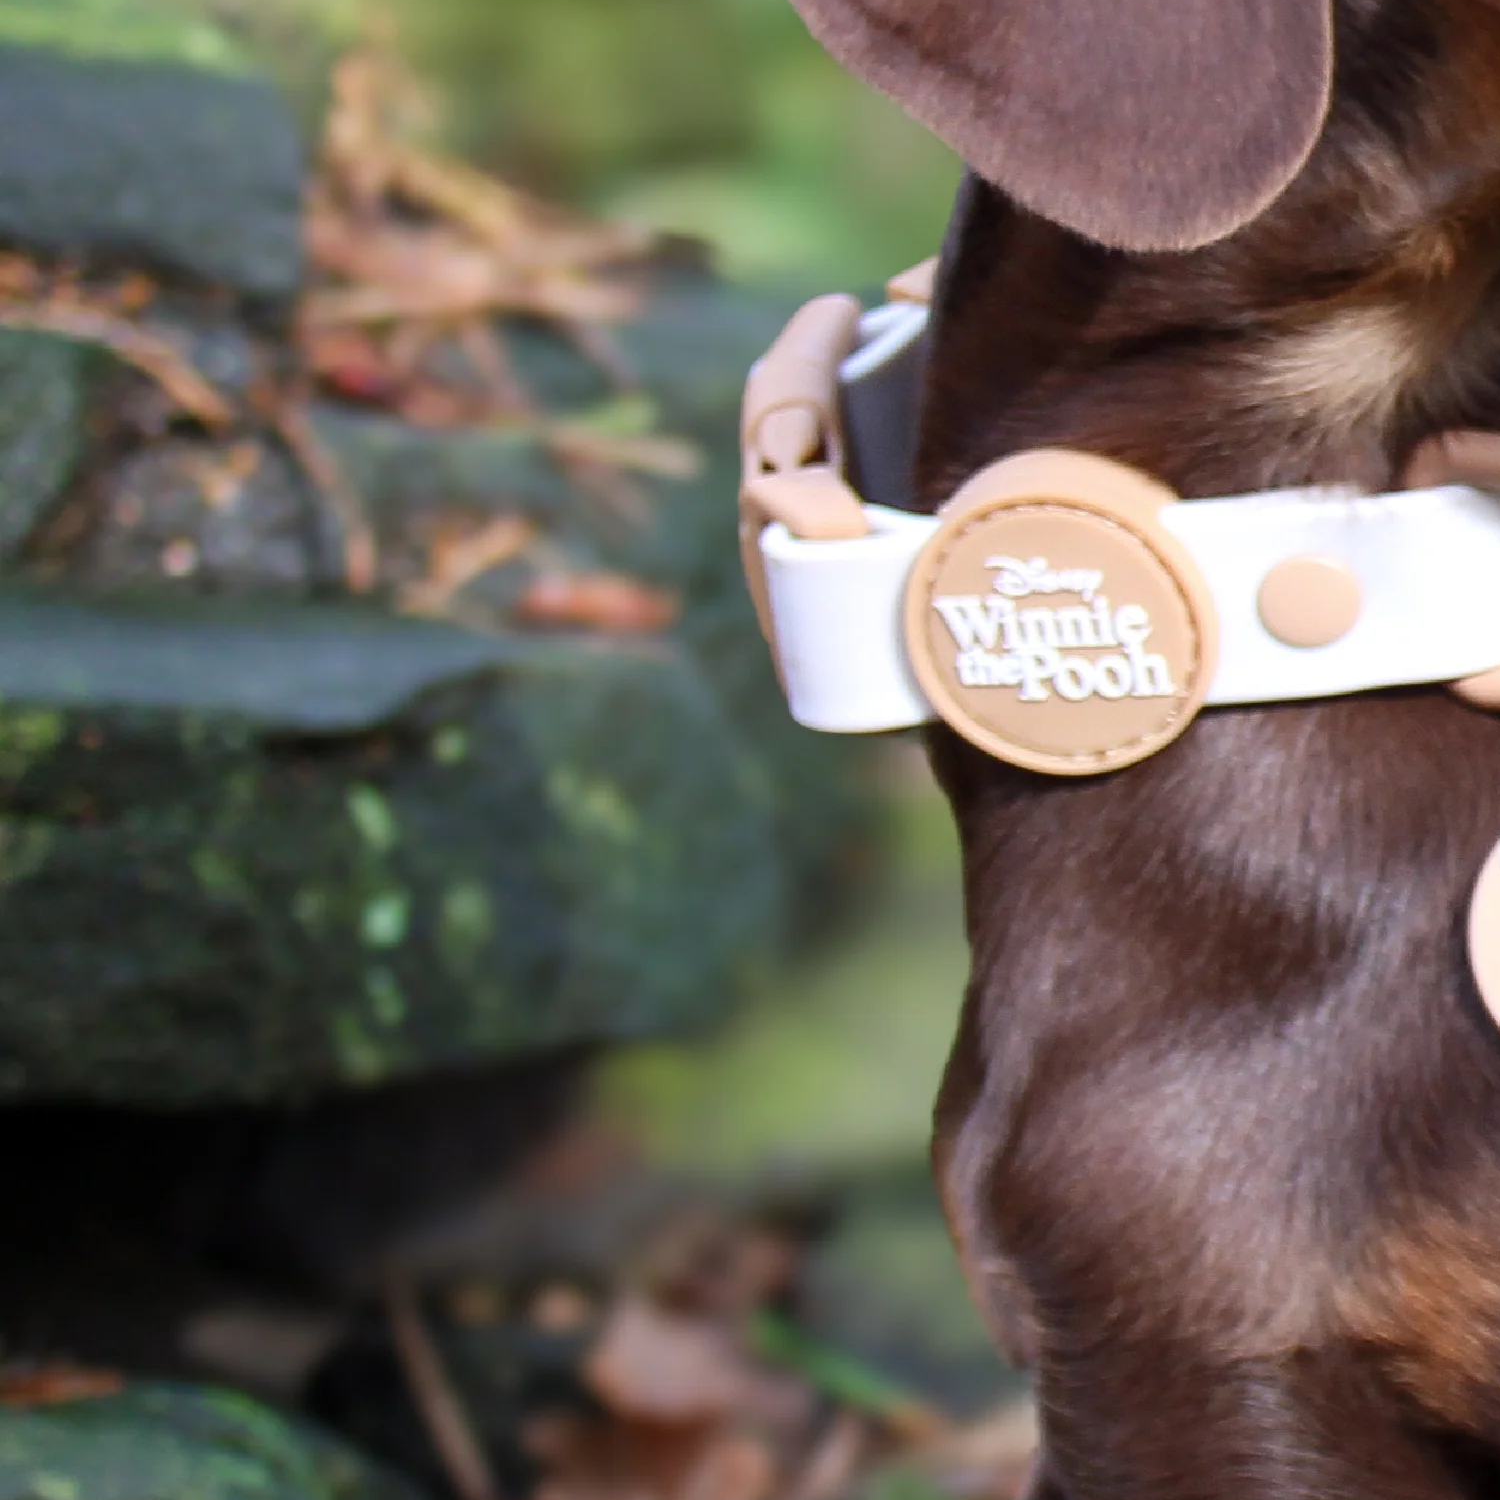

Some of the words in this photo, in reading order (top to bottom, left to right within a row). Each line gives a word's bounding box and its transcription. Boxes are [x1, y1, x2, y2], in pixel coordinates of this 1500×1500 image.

[984, 555, 1103, 601] Disney
[933, 594, 1153, 649] Winnie
[957, 648, 1022, 686] the
[1017, 638, 1177, 701] Pooh
